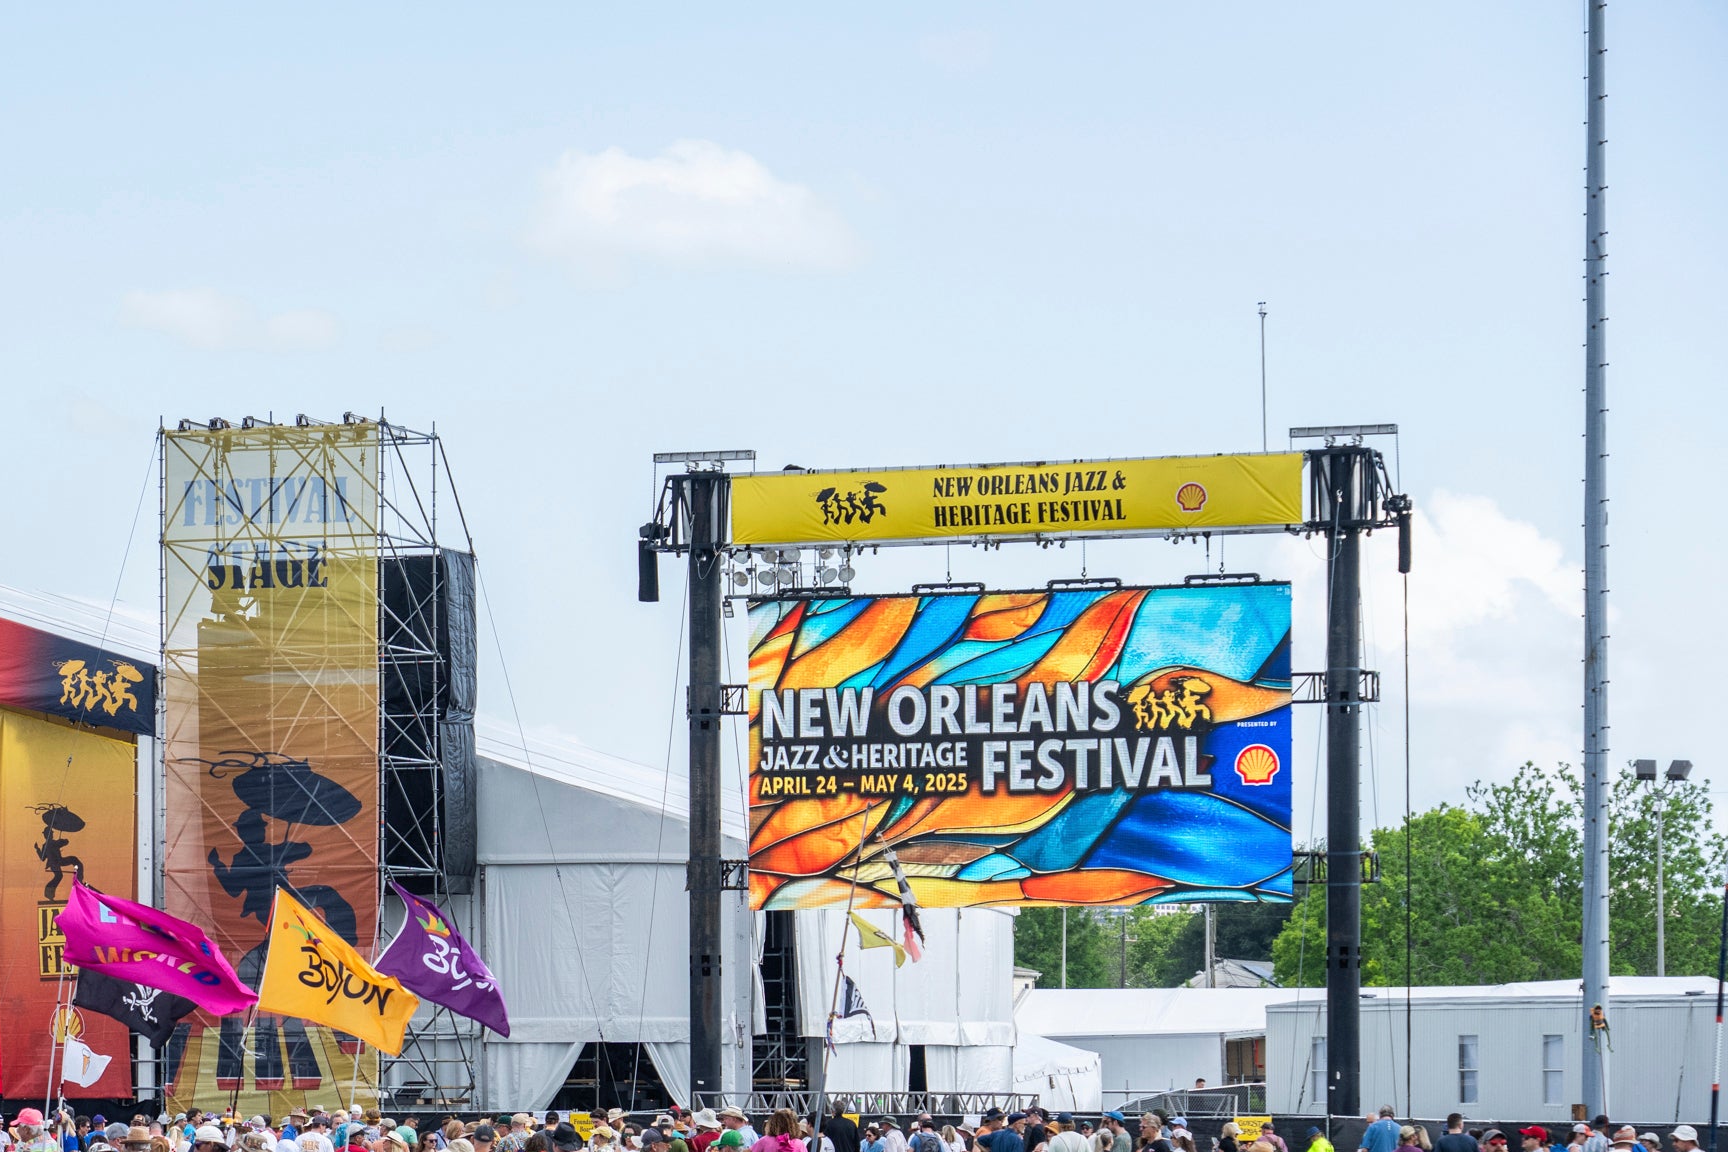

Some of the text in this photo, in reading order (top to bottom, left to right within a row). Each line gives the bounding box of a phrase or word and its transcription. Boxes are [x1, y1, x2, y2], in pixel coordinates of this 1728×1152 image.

[183, 475, 356, 527] FESTIVAL
[933, 470, 1127, 498] NEW ORLEANS JAZZ &
[934, 498, 1127, 528] HERITAGE FESTIVAL
[208, 541, 328, 590] STAGE
[760, 680, 1122, 740] NEW ORLEANS
[760, 741, 967, 771] JAZZ & HERITAGE
[982, 735, 1212, 792] FESTIVAL
[760, 775, 811, 795] APRIL
[816, 774, 838, 793] 24
[860, 774, 900, 793] MAY
[902, 774, 920, 797] 4,
[925, 772, 968, 792] 2025
